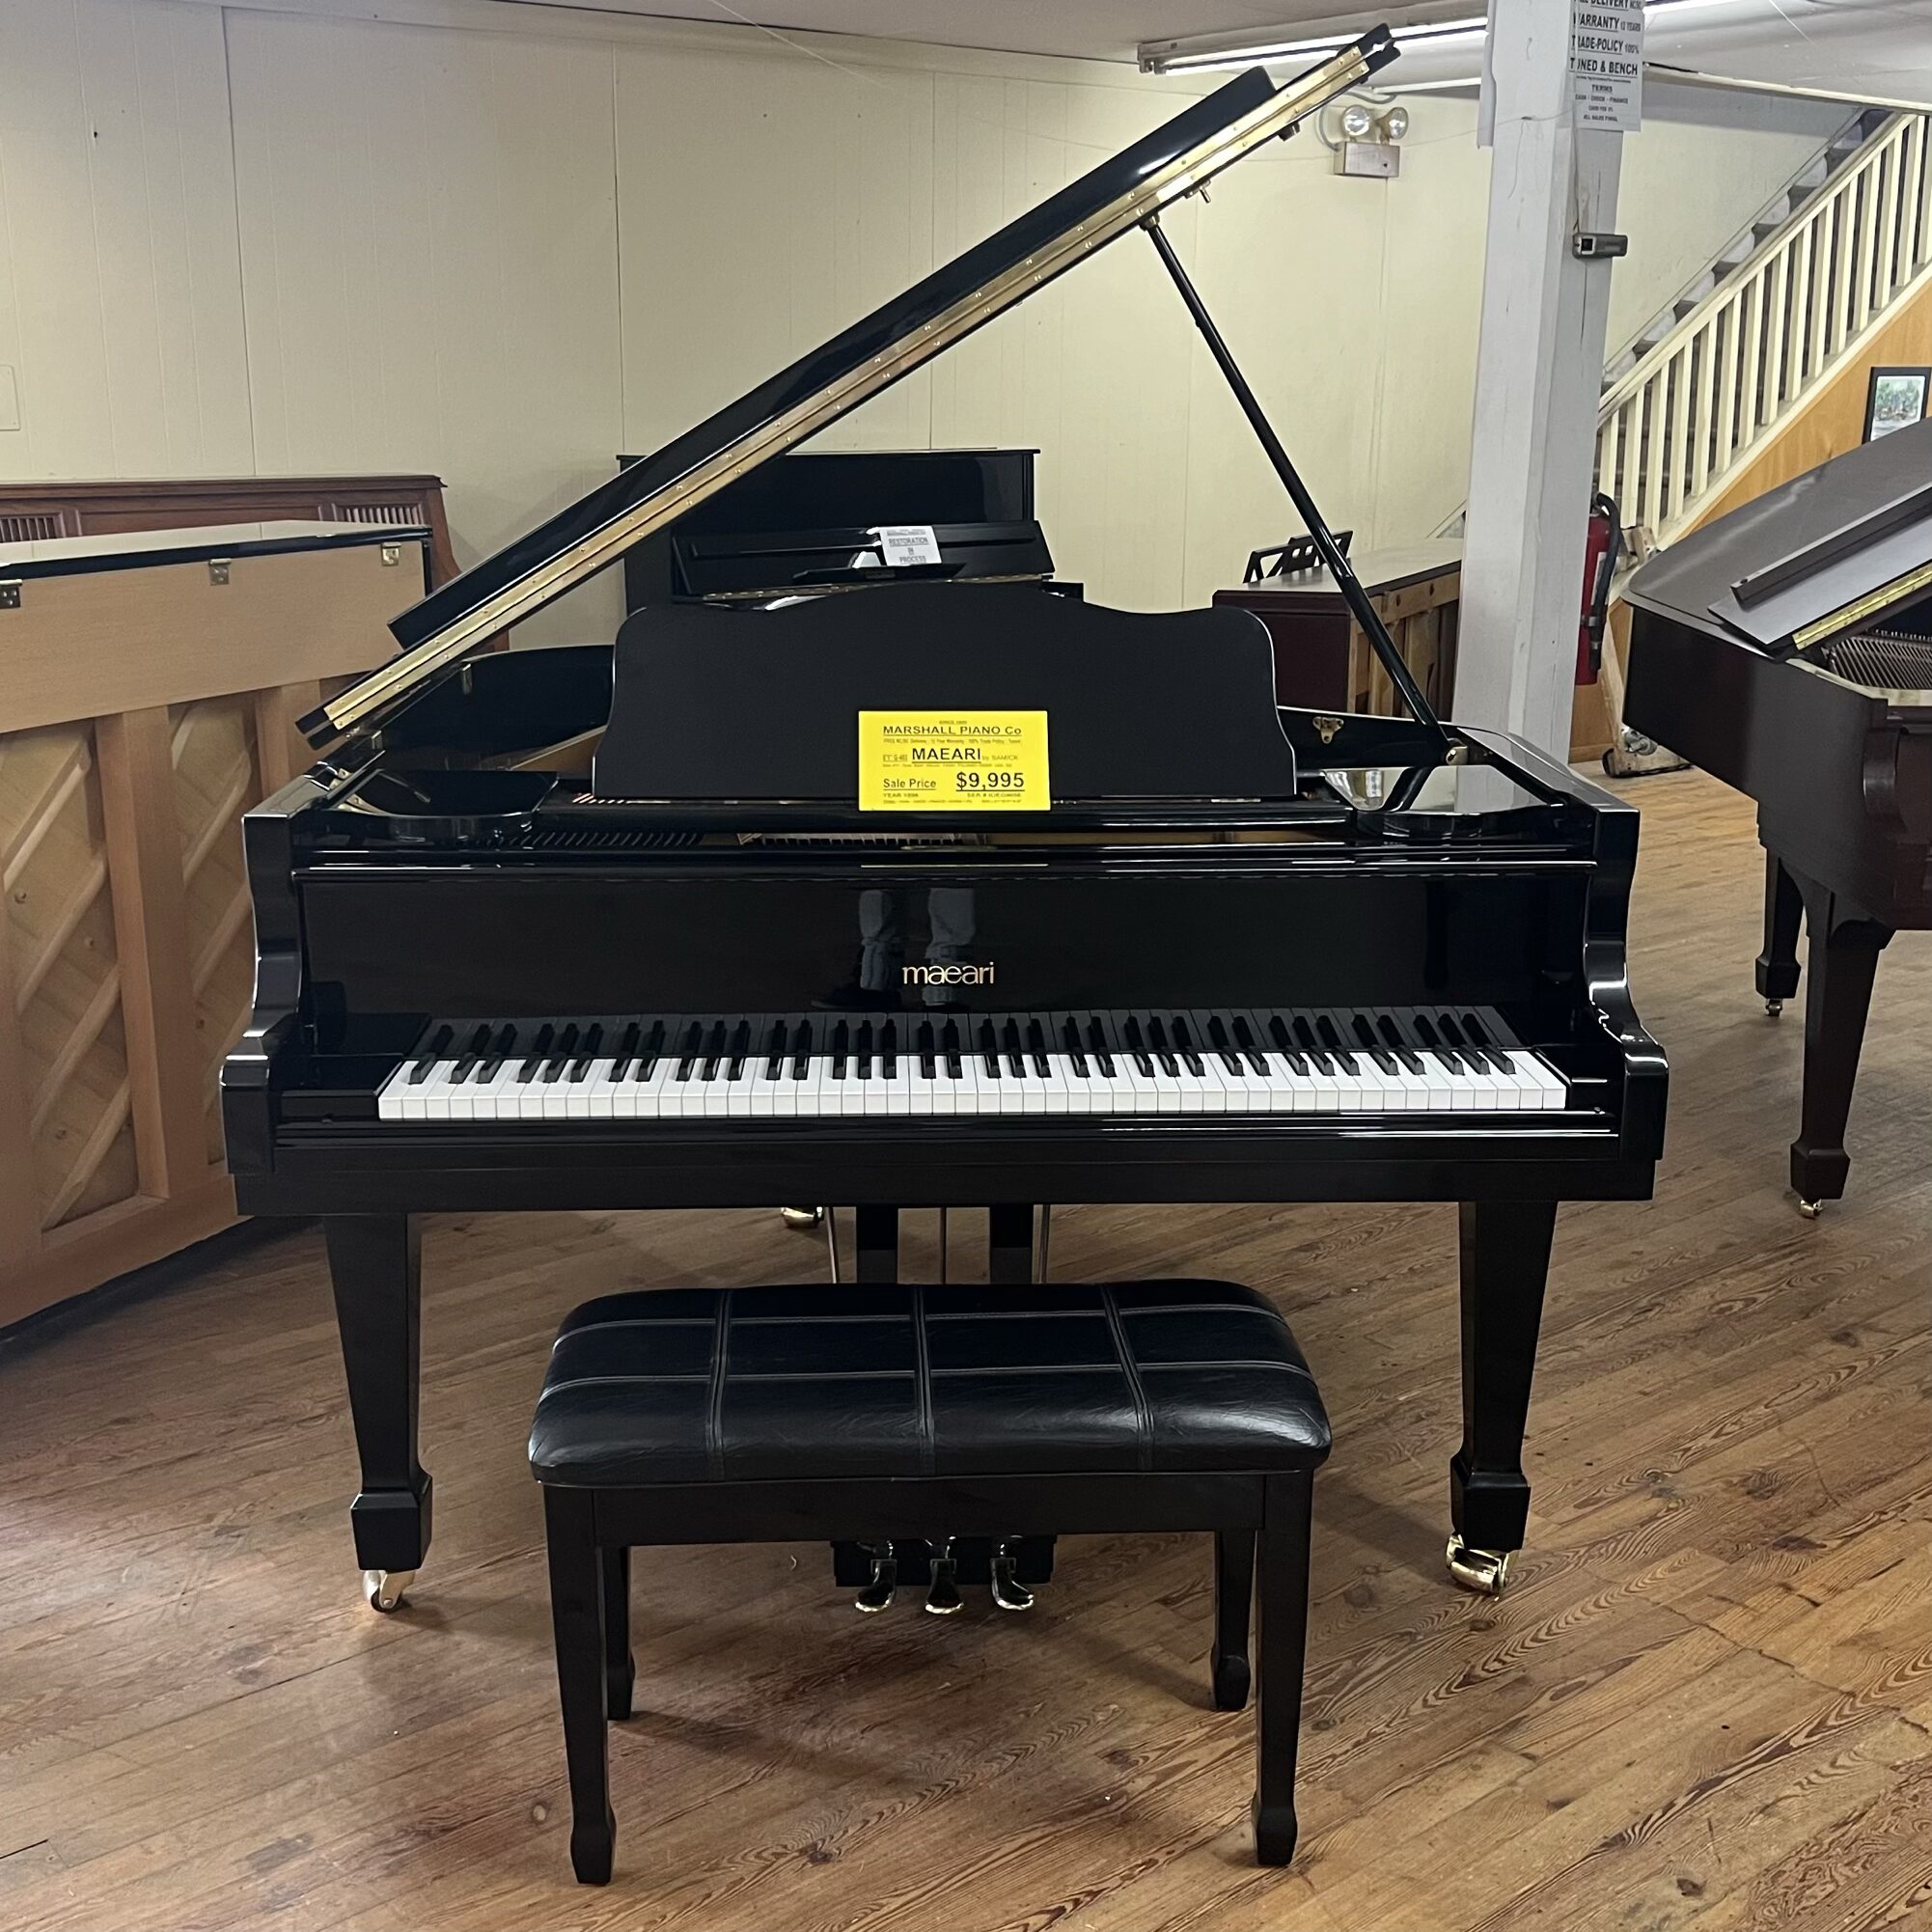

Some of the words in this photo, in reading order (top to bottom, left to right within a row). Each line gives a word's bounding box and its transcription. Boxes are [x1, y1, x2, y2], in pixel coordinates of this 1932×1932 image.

[1600, 60, 1606, 72] &
[1609, 61, 1639, 75] BENCH
[888, 537, 929, 546] RESTORATION
[883, 726, 956, 734] MARSHALL
[959, 726, 1001, 734] PIANO
[1005, 726, 1022, 734] Co
[912, 747, 980, 760] MAEARI
[883, 778, 906, 788] Sale
[909, 778, 937, 788] Price
[956, 771, 1025, 791] $9,995
[901, 961, 994, 984] maeari
